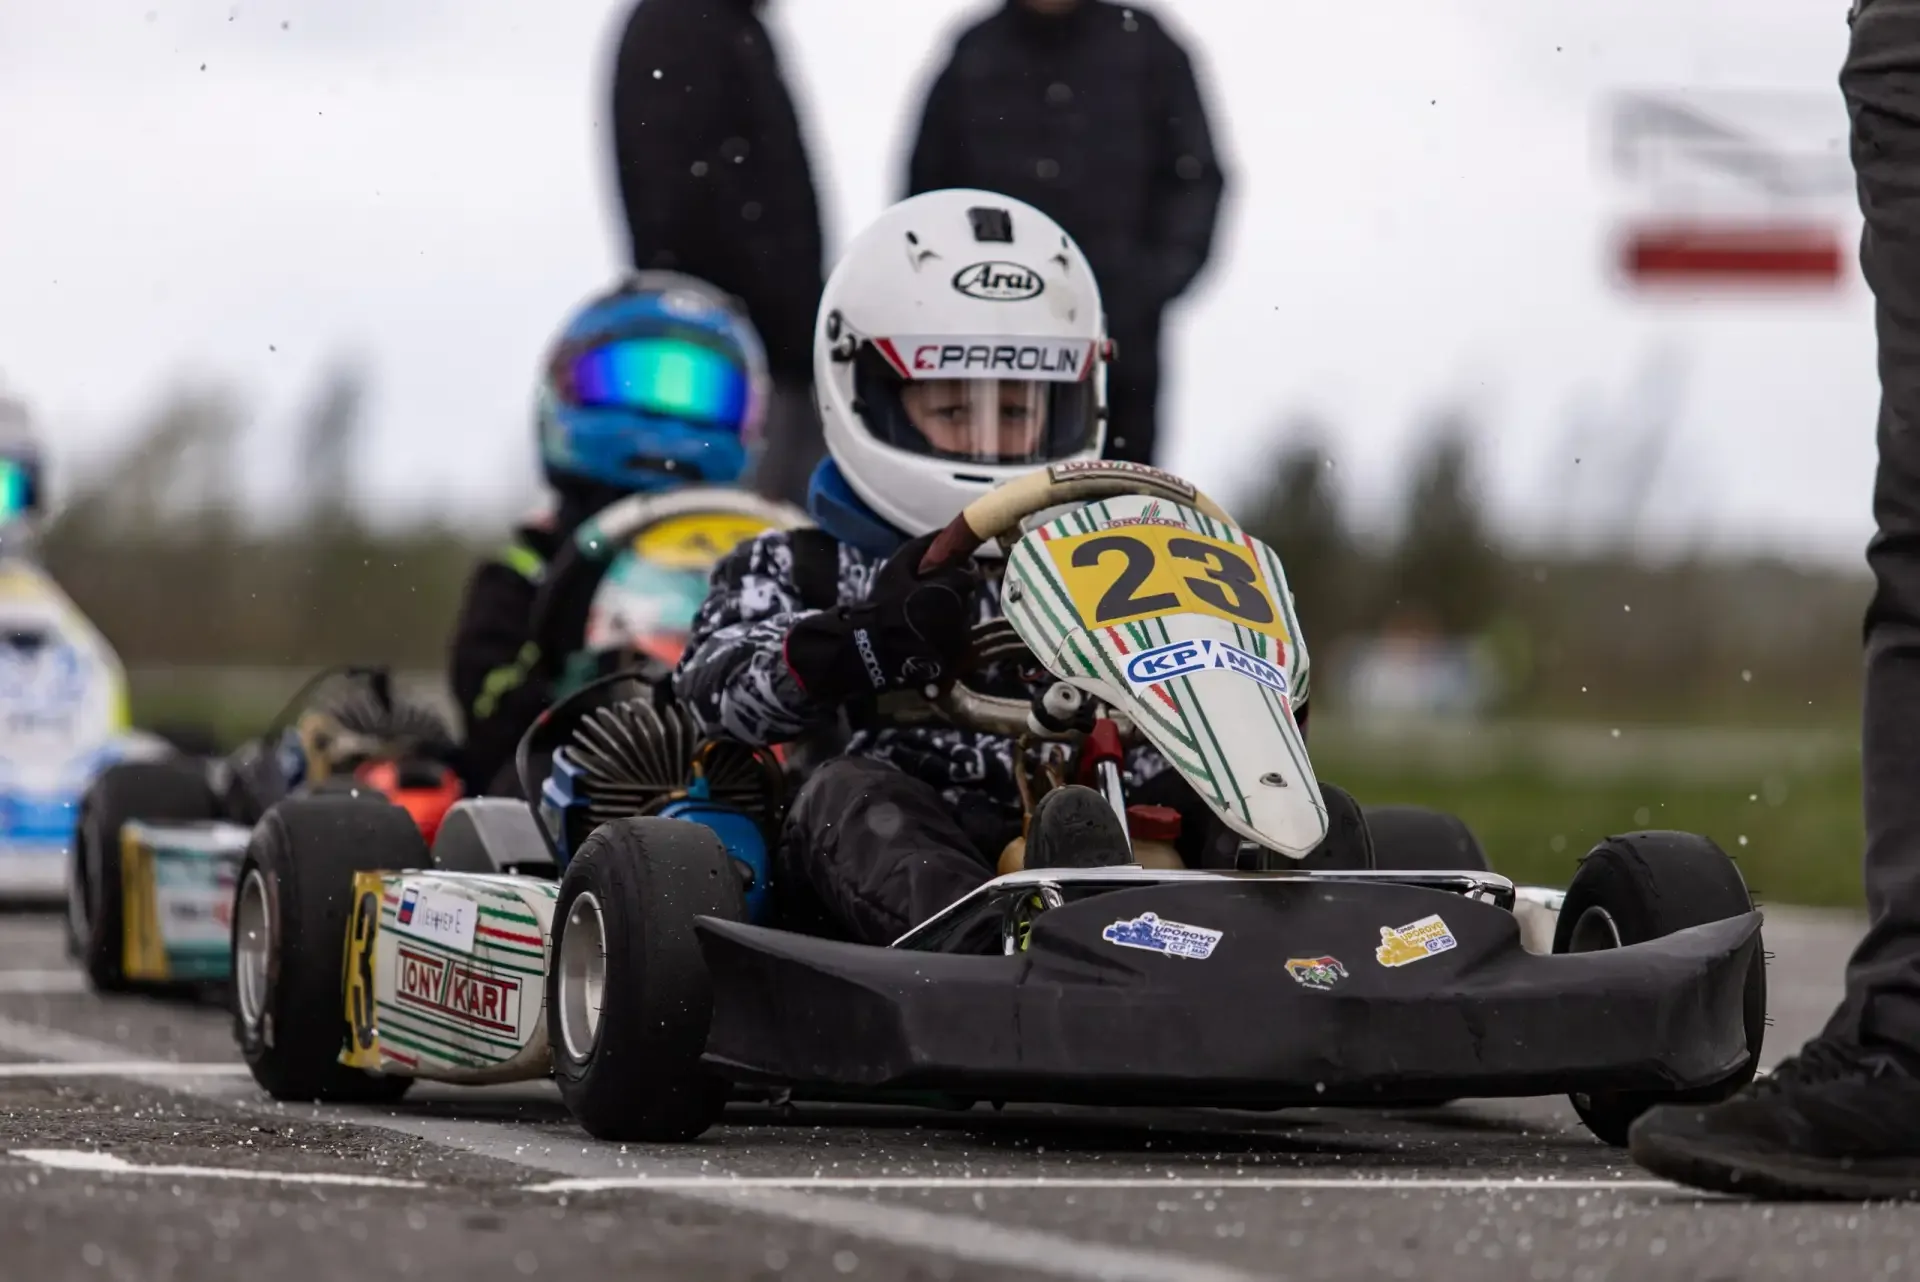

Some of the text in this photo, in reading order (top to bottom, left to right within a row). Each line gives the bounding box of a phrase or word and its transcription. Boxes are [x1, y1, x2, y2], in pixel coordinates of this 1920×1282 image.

[960, 264, 1033, 290] Arai
[938, 345, 1079, 373] PAROLIN
[1071, 536, 1274, 624] 23
[1155, 926, 1217, 943] UPOROVO
[399, 948, 518, 1022] TONY KART
